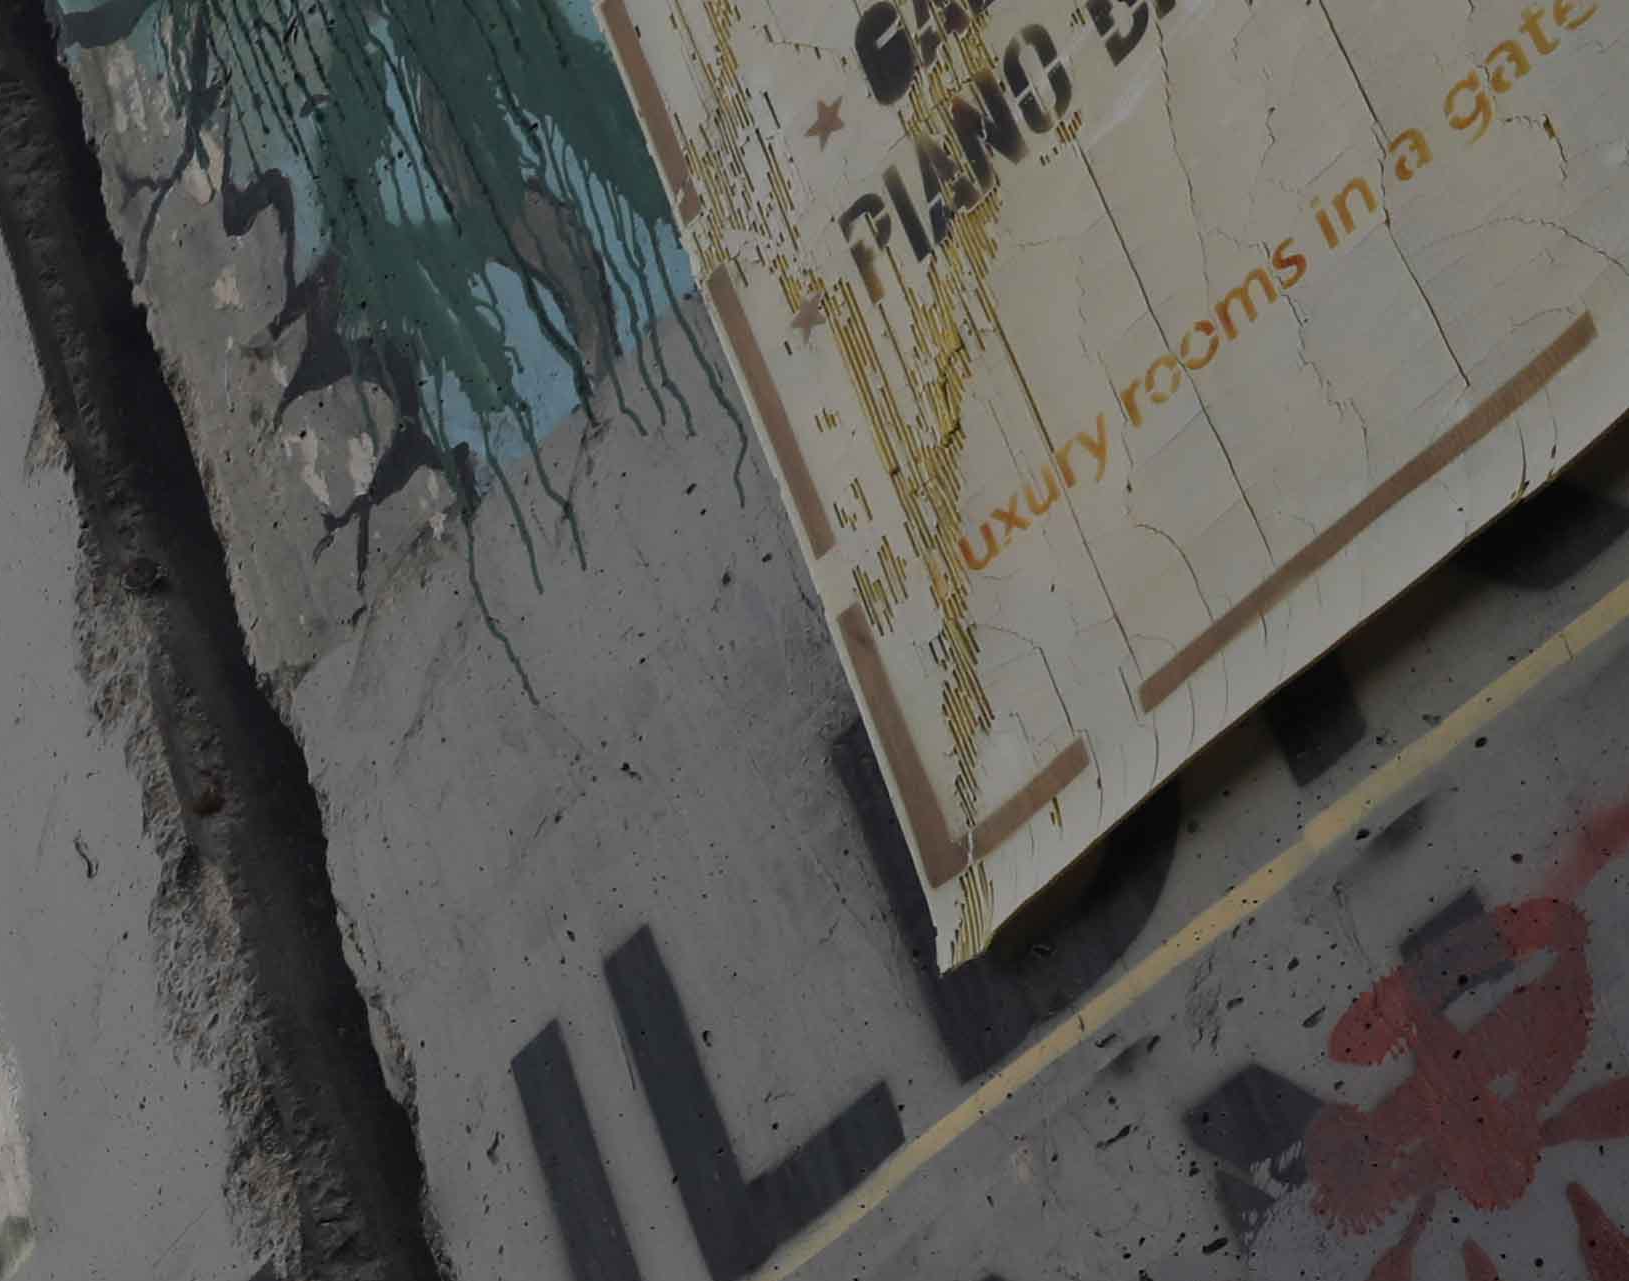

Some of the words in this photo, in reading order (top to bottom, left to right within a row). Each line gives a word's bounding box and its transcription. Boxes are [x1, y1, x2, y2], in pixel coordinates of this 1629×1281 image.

[838, 24, 1073, 304] PIANO
[930, 412, 1108, 598] uxury
[1121, 236, 1309, 432] rooms
[1311, 174, 1378, 251] in
[1388, 127, 1433, 181] a
